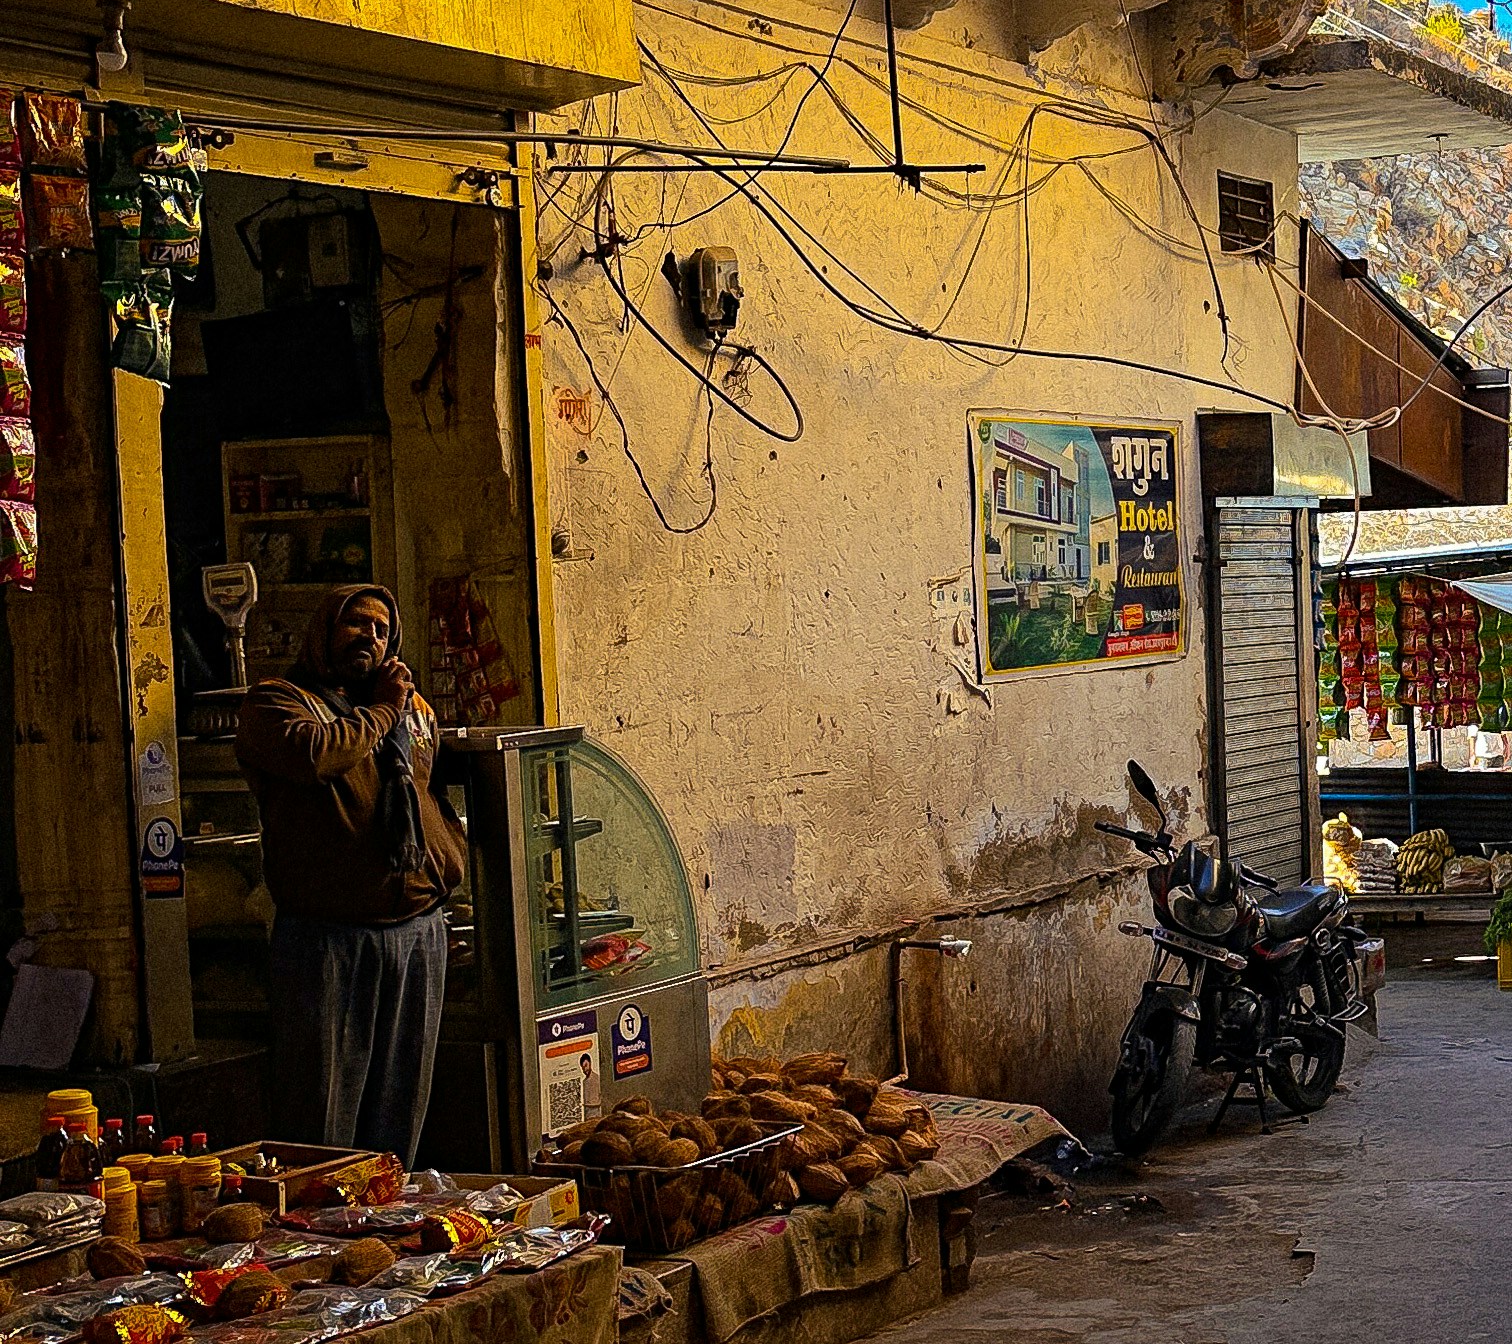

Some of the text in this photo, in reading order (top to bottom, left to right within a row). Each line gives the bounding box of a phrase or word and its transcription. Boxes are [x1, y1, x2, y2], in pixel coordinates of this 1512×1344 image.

[1110, 435, 1169, 496] शगुन
[1118, 500, 1174, 532] Hotel
[1142, 535, 1155, 560] &
[1121, 564, 1177, 588] Restauran
[142, 859, 179, 871] PhonePe
